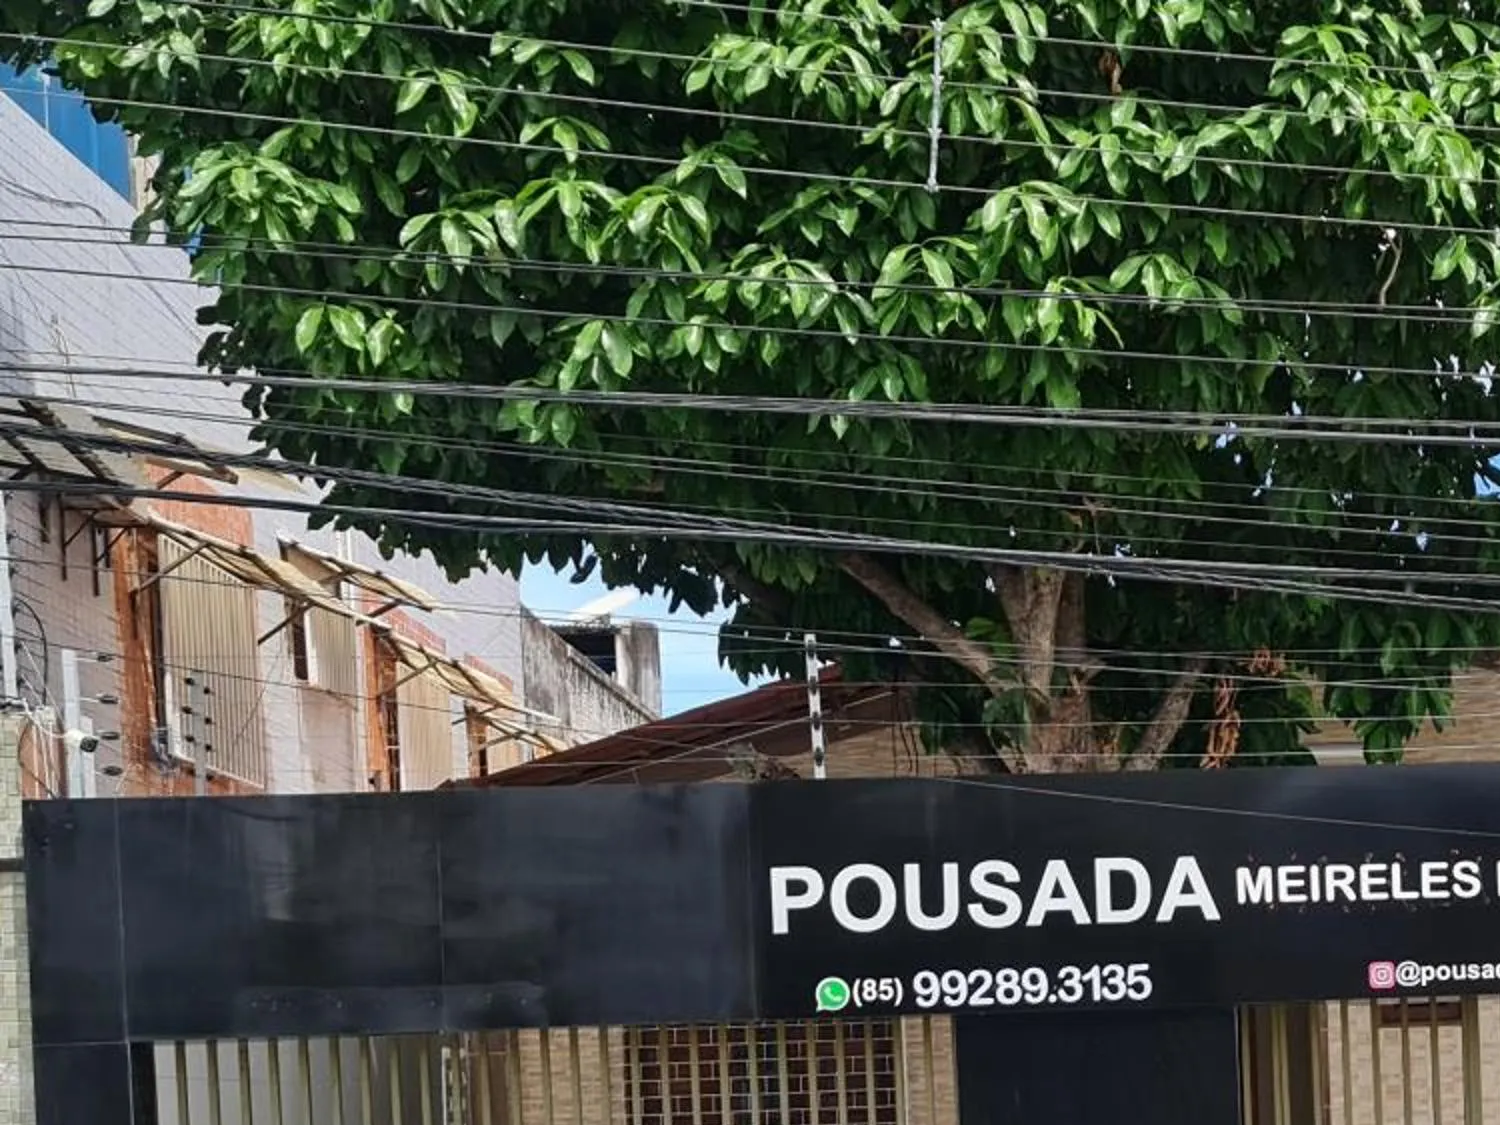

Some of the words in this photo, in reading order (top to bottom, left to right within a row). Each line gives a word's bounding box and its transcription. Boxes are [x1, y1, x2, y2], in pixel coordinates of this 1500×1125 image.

[770, 855, 1221, 935] POUSADA
[1235, 860, 1482, 904] MEIRELES
[852, 977, 903, 1006] (85)
[913, 963, 1153, 1008] 99289.3135
